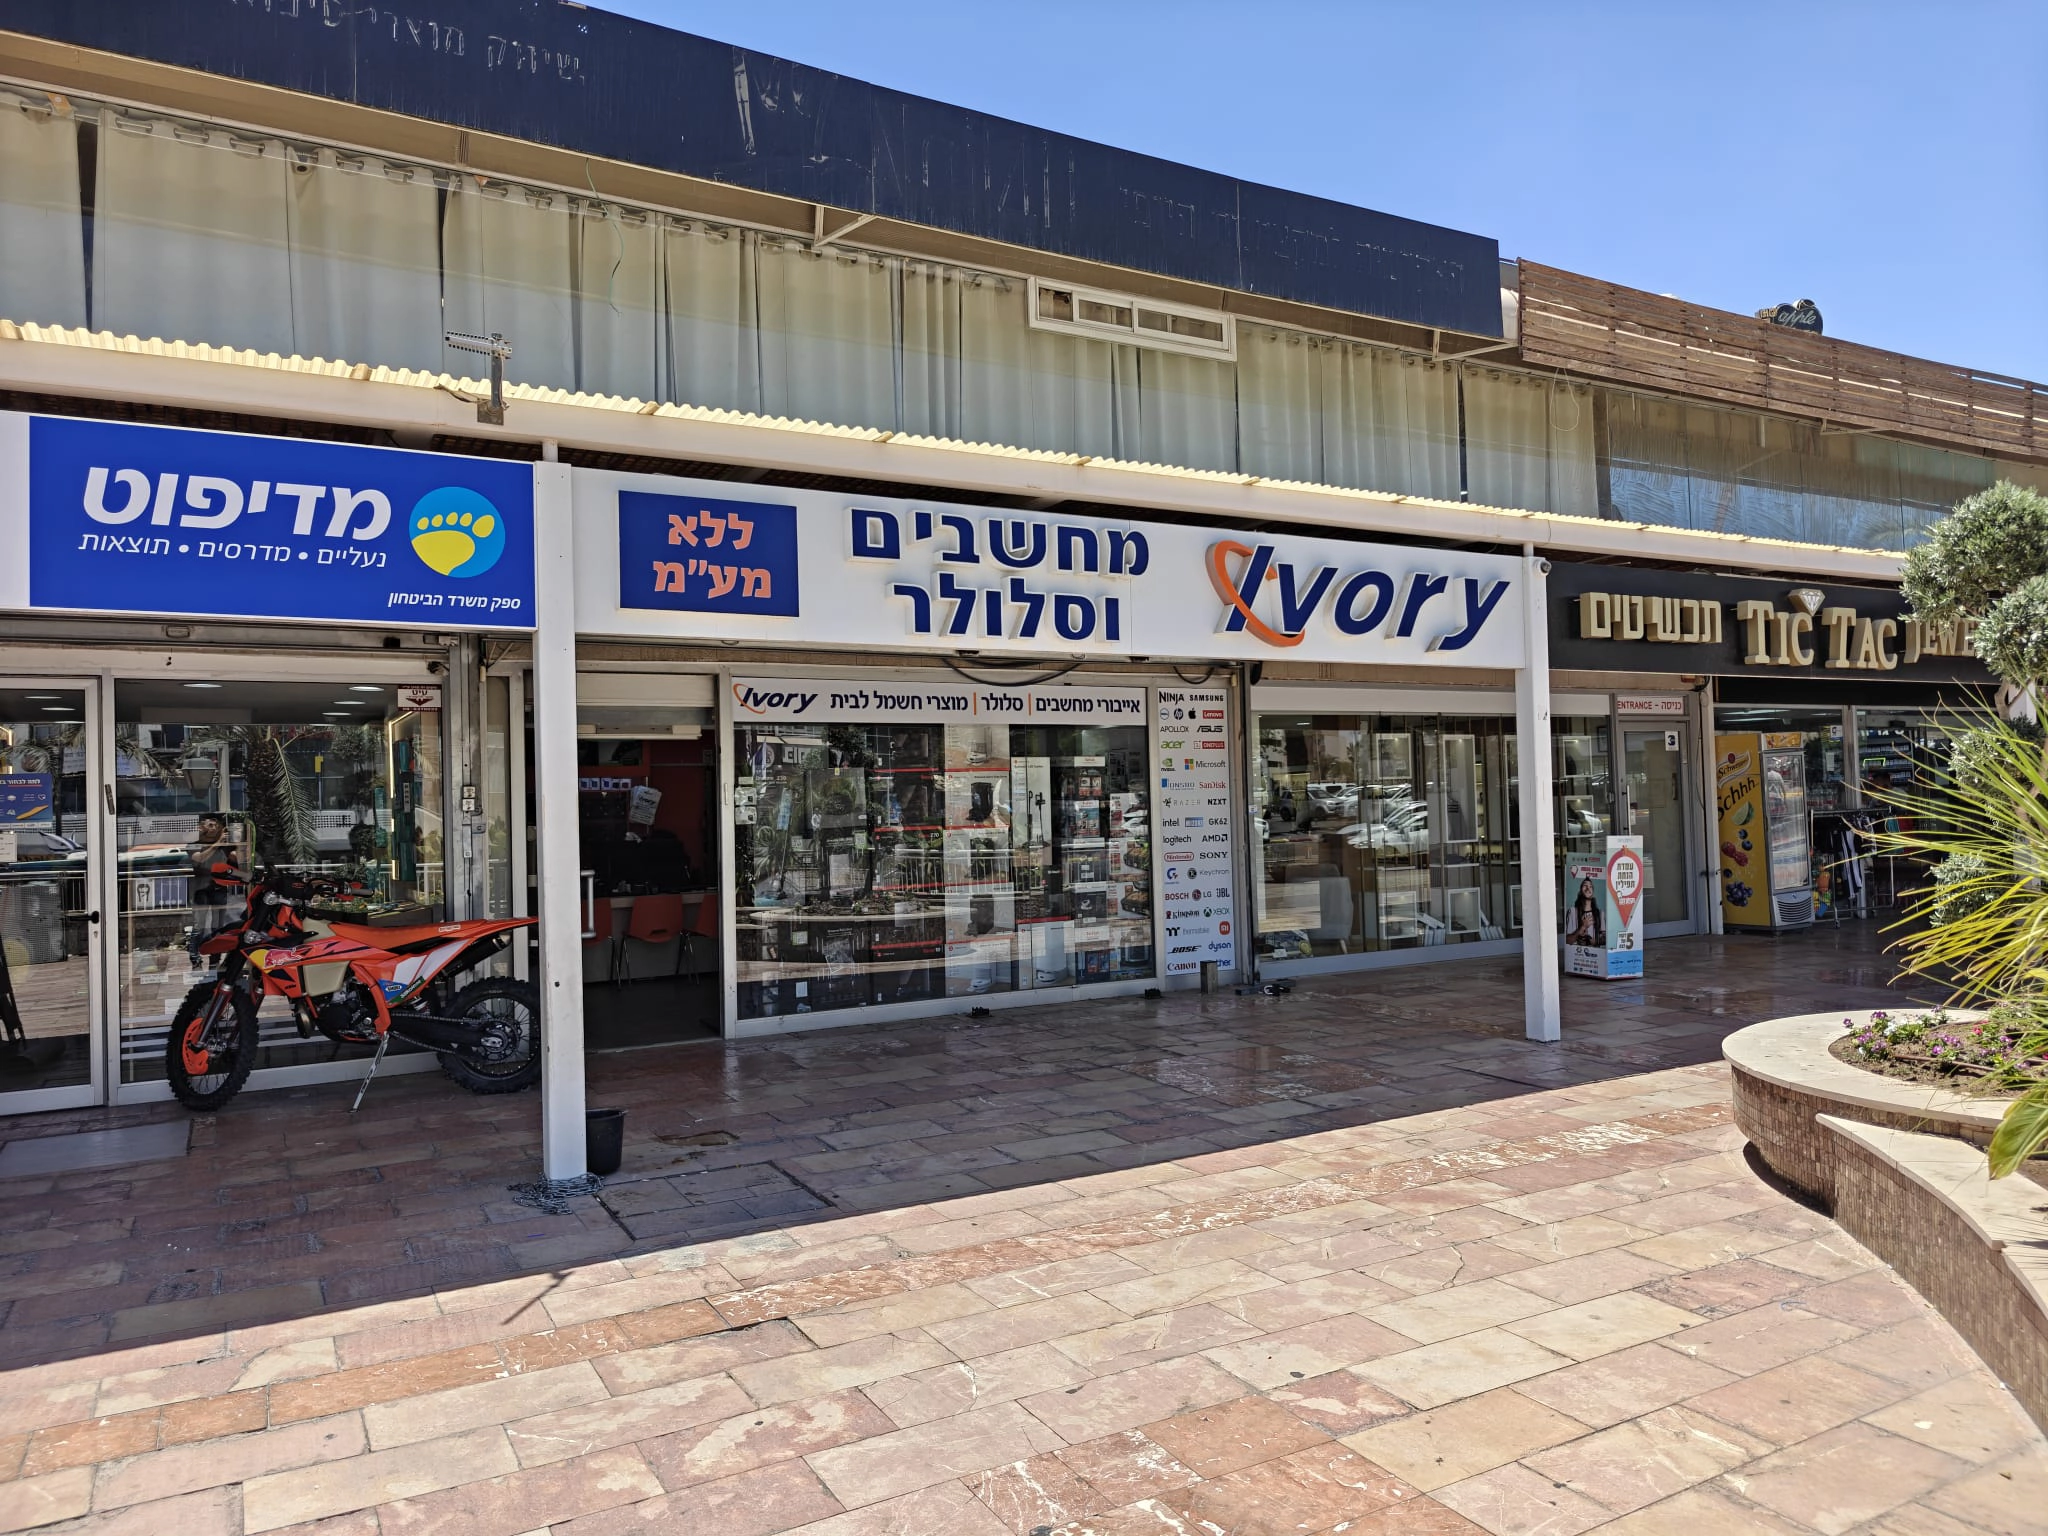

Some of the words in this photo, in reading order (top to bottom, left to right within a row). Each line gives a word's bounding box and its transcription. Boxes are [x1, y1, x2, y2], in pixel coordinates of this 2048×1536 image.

[1778, 310, 1816, 327] apple
[82, 466, 392, 541] מדיפוט
[668, 510, 754, 550] ללא
[78, 532, 170, 555] תוצאות
[848, 507, 1150, 577] מחשבים
[198, 541, 291, 562] מדרסים
[317, 547, 387, 568] נעליים
[387, 591, 443, 607] הביטחון
[446, 593, 487, 608] משרד
[490, 595, 521, 611] ספק
[1215, 544, 1511, 652] Ivory
[888, 571, 1121, 642] וסלולר
[1580, 591, 1722, 644] תכשיטים
[1737, 599, 1815, 667] TIC
[1822, 606, 1899, 670] TAC
[1904, 615, 1976, 664] JEWE
[738, 686, 818, 714] Ivory
[830, 690, 870, 711] לבית
[874, 689, 922, 711] חשמל
[927, 692, 968, 711] מוצרי
[980, 693, 1024, 712] סלולר
[1036, 695, 1093, 713] מחשבים
[1097, 697, 1140, 713] אייבורי
[1189, 694, 1224, 702] SAMSUNG
[1617, 701, 1652, 710] ENTRANCE
[1661, 701, 1682, 710] כניסה
[1196, 725, 1224, 733] ASUS
[1160, 740, 1185, 749] acer
[1195, 760, 1226, 768] Microsoft
[1199, 781, 1226, 789] SanDisk
[1207, 798, 1226, 806] NZXT
[1162, 818, 1179, 827] intel
[1162, 835, 1192, 846] logitech
[1201, 834, 1221, 842] AMD
[1199, 851, 1228, 859] SONY
[1164, 893, 1189, 901] BOSCH
[1213, 907, 1230, 915] XBOX
[1168, 945, 1202, 954] BOSE
[1208, 940, 1231, 952] dyson
[1626, 932, 1634, 950] 5
[1167, 962, 1197, 971] Canon
